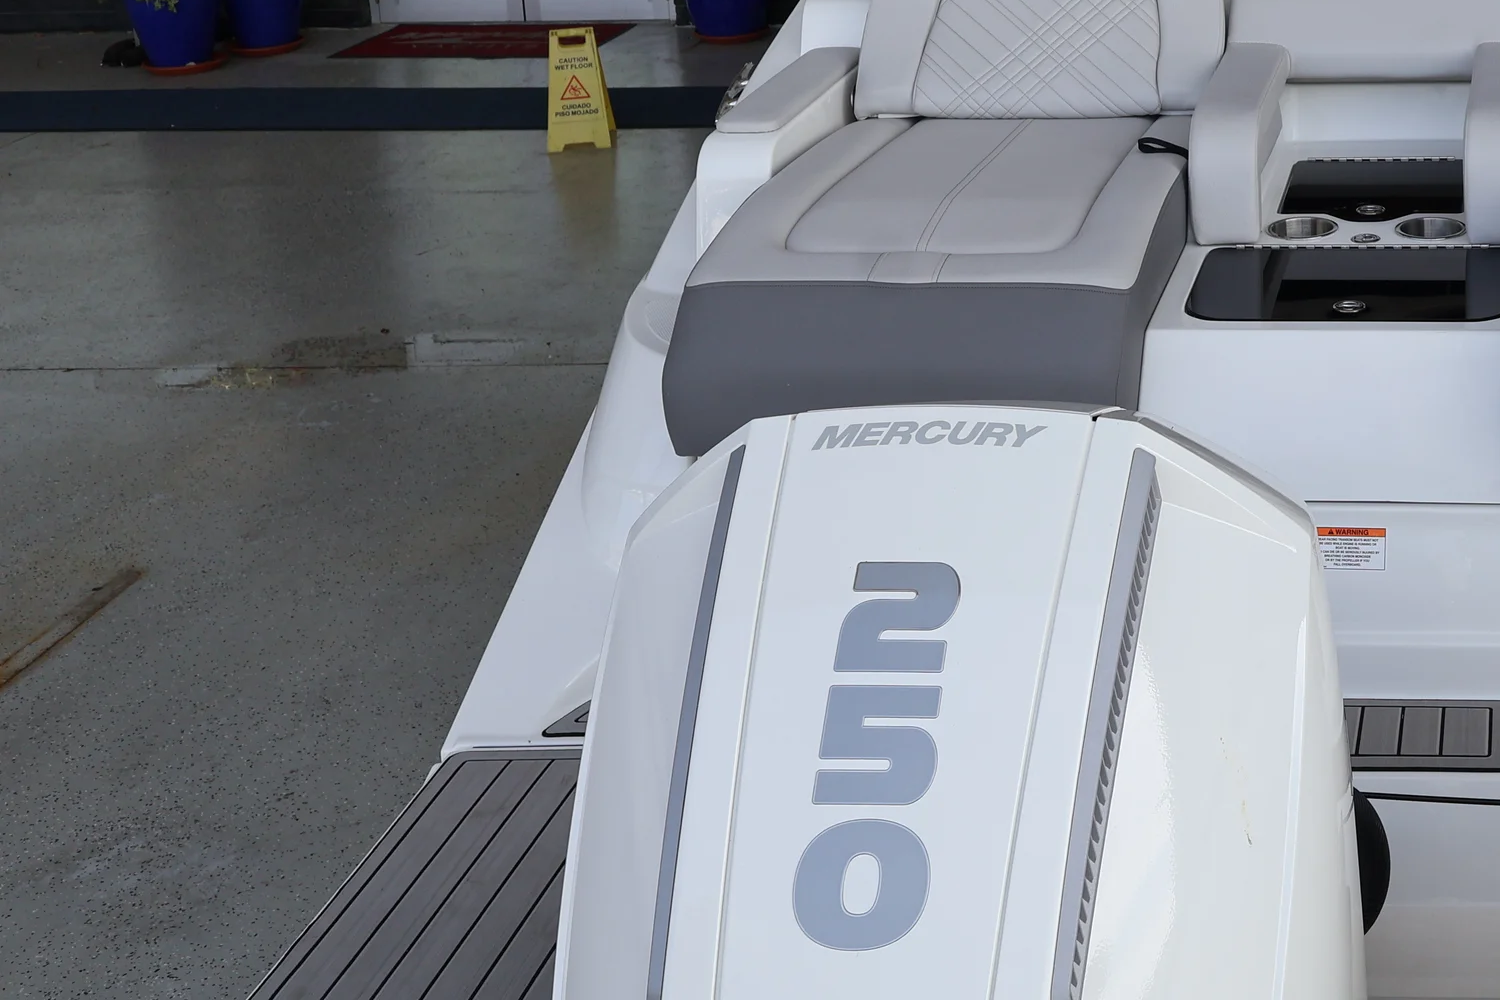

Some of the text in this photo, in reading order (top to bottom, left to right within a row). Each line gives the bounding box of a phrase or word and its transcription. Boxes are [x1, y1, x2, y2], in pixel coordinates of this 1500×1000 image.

[559, 56, 588, 64] CAUTION
[570, 62, 593, 70] FLOOR
[571, 108, 599, 116] MOJADO
[810, 420, 1049, 451] MERCURY
[792, 561, 962, 952] 250
